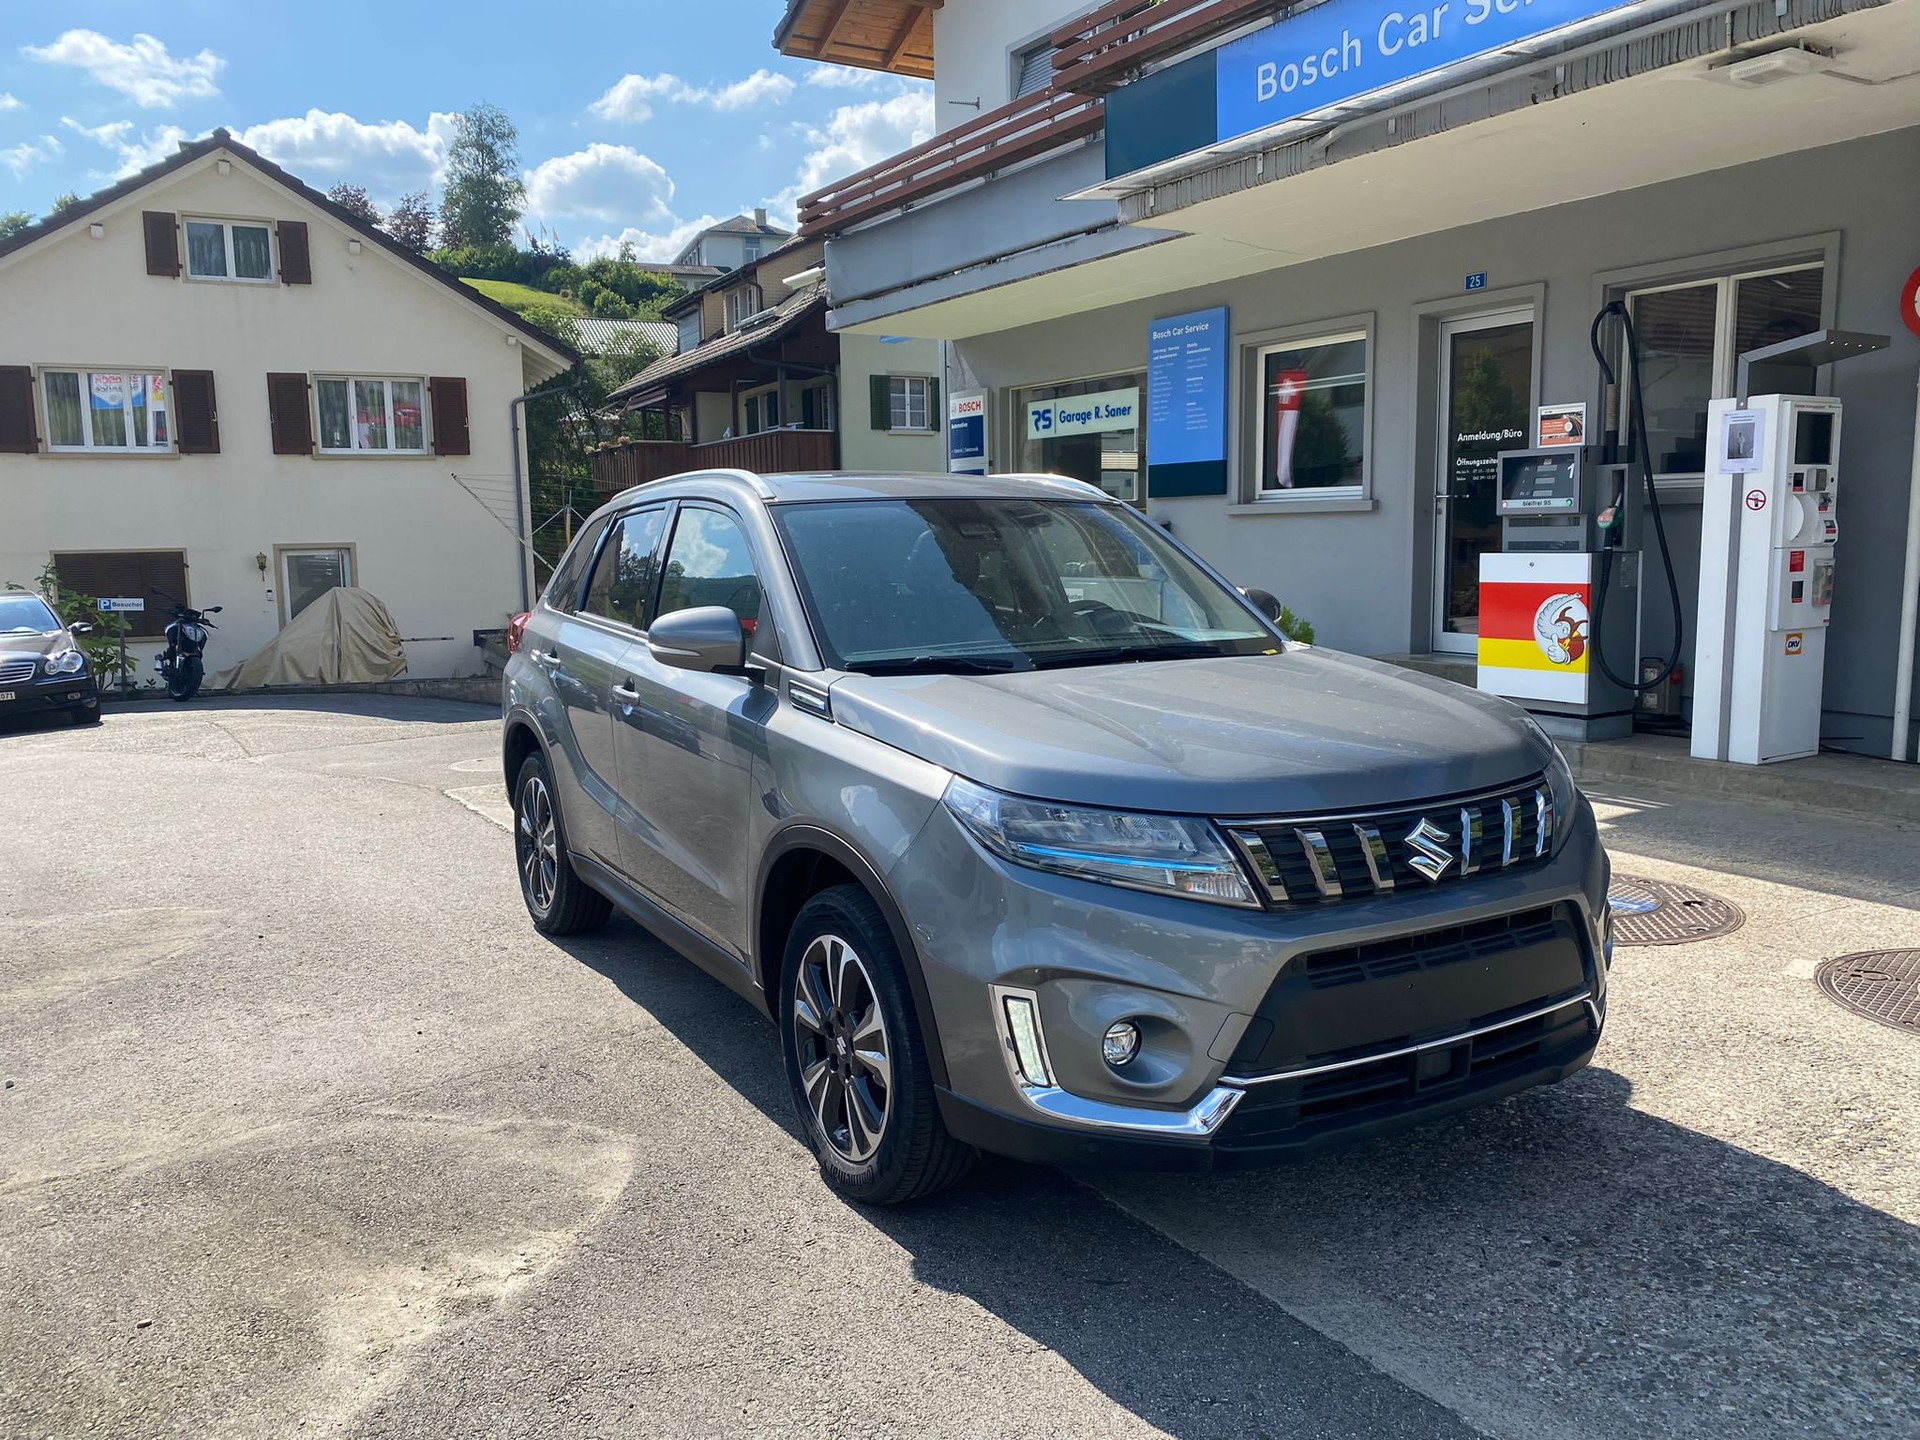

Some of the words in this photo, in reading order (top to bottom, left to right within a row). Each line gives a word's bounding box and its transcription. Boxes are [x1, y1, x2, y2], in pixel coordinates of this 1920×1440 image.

[1256, 28, 1362, 103] Bosch
[1377, 2, 1448, 57] Car
[1469, 275, 1481, 288] 25
[1152, 329, 1171, 340] Bosch
[1172, 327, 1184, 336] Car
[1184, 322, 1210, 334] Service
[958, 400, 981, 413] BOSCH
[1058, 409, 1092, 425] Garage
[1094, 405, 1103, 419] R.
[1104, 404, 1132, 418] Saner
[1457, 429, 1523, 442] Anmeldung/Büro
[1567, 462, 1575, 479] 1
[1787, 640, 1800, 648] DKV
